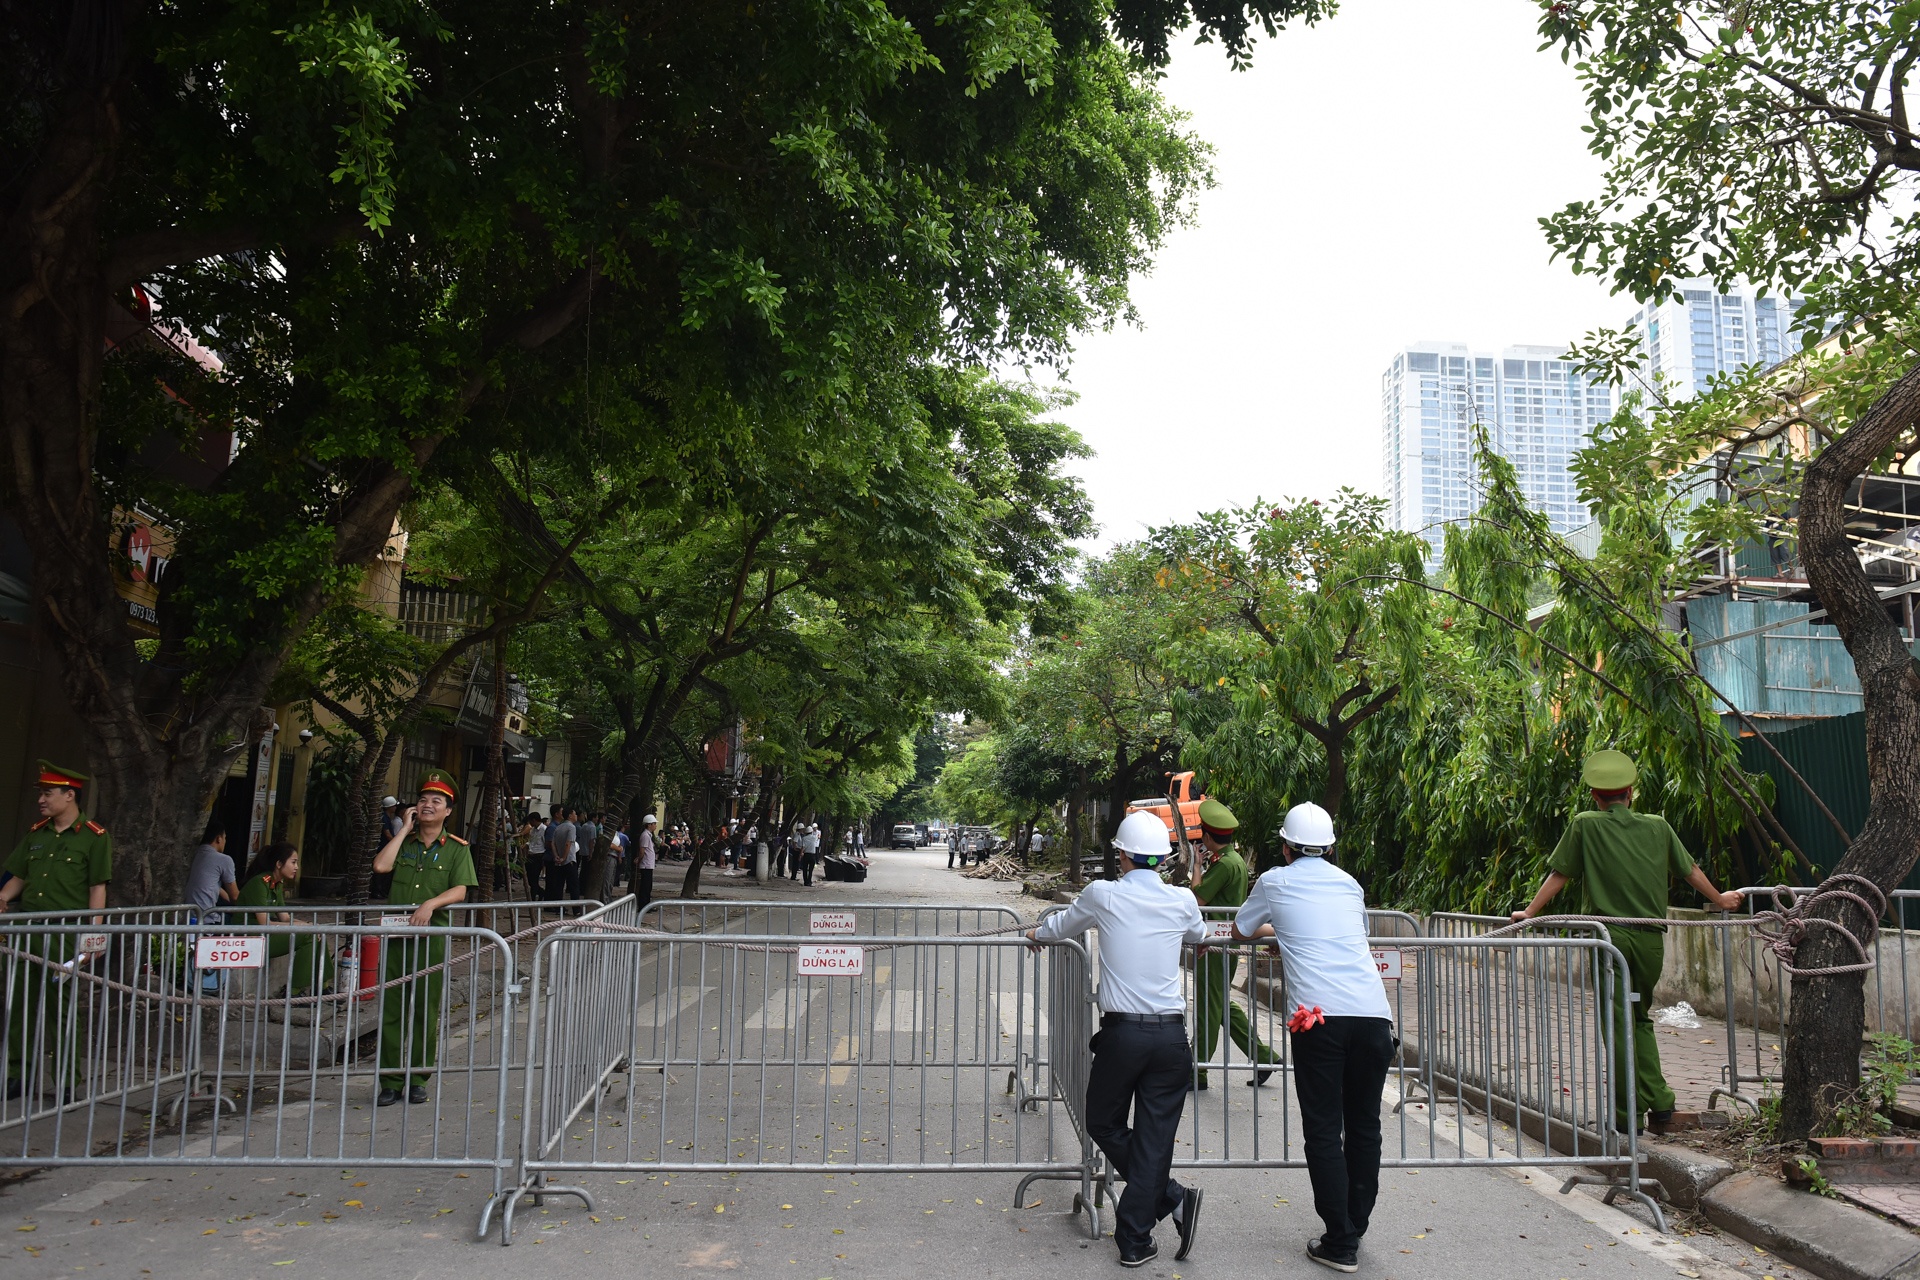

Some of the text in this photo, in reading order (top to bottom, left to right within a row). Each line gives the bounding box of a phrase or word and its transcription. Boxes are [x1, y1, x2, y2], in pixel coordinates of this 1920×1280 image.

[129, 602, 144, 620] 0973
[87, 936, 105, 947] STOP
[210, 951, 249, 962] STOP
[802, 955, 859, 970] DỪNG LẠI
